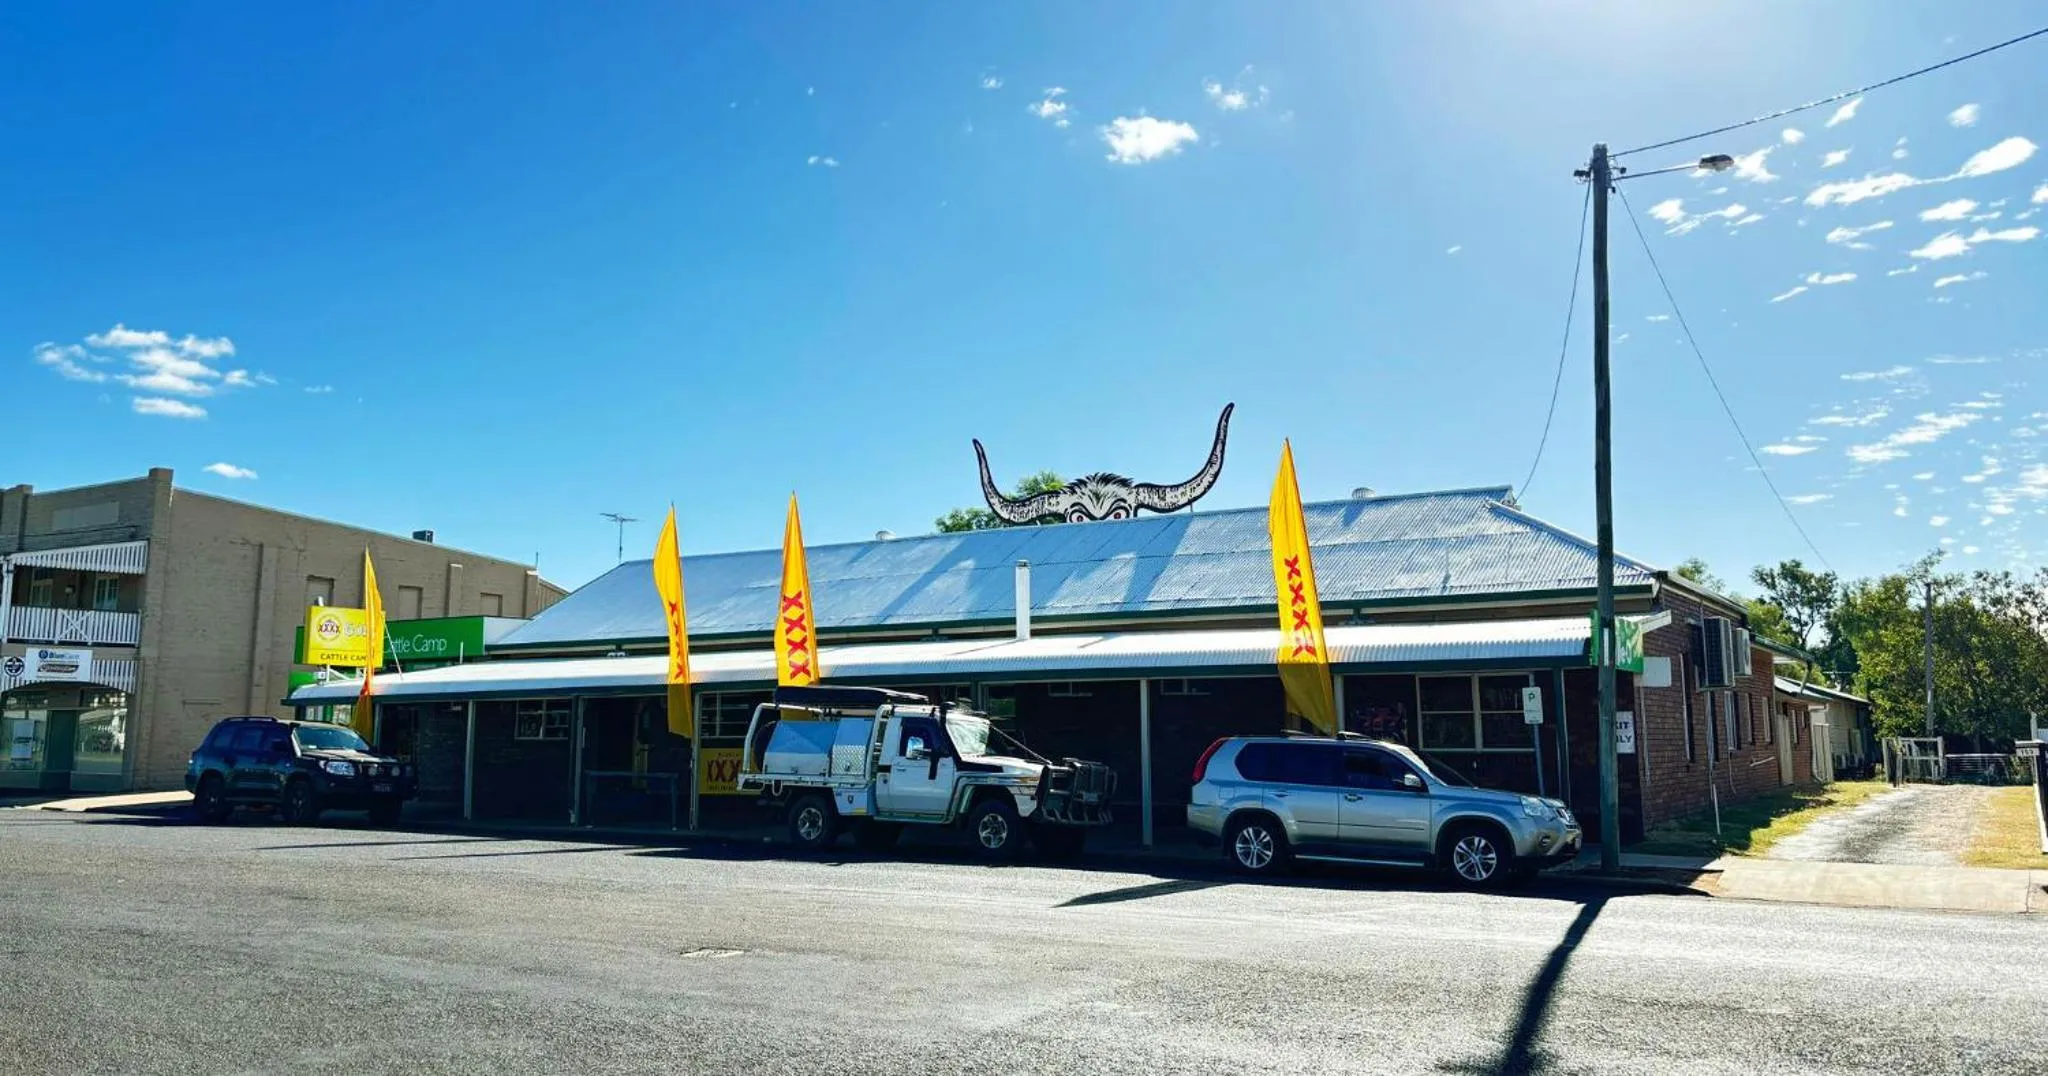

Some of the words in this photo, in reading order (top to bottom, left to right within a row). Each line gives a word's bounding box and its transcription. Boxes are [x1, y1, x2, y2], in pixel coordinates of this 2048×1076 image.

[1284, 553, 1317, 657] XXXX
[318, 622, 341, 633] XXXX
[783, 591, 812, 680] XXXX
[412, 633, 448, 657] Camp
[350, 654, 367, 662] CAM
[1528, 692, 1536, 703] P
